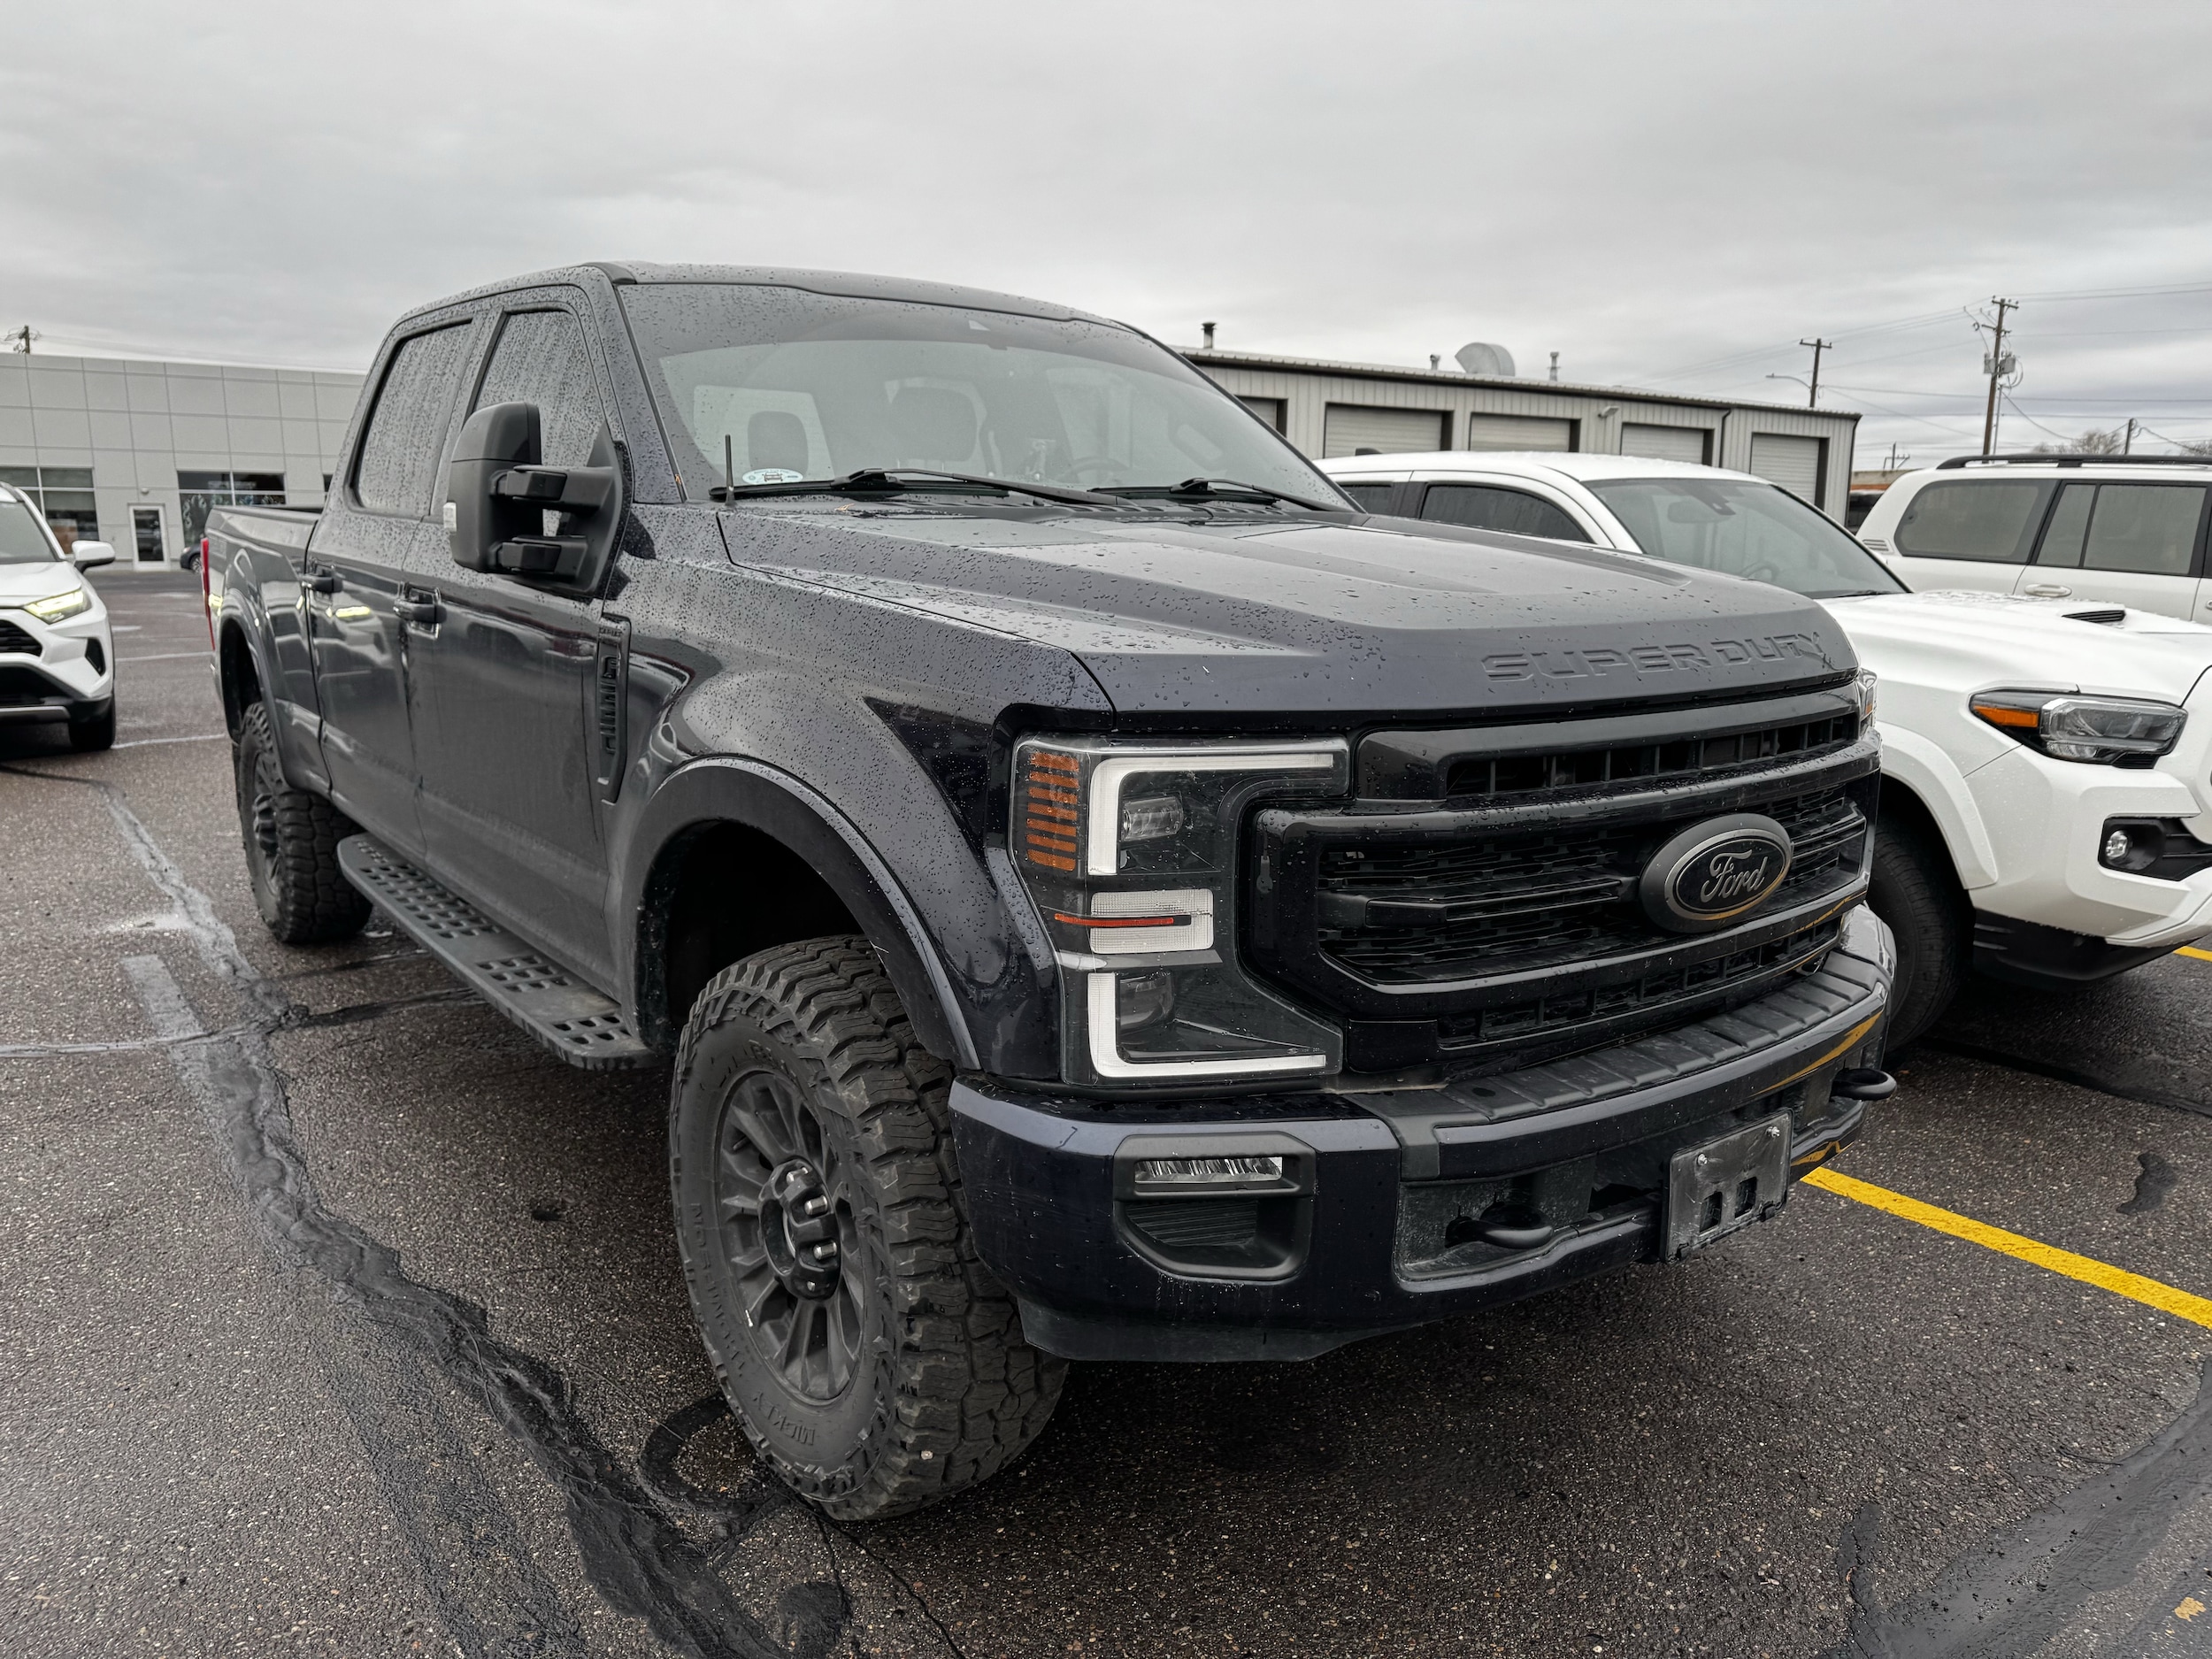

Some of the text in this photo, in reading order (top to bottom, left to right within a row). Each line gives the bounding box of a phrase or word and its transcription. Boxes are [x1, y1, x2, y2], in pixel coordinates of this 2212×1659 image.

[1481, 632, 1824, 681] SUPER DUTY
[1700, 849, 1769, 903] Ford
